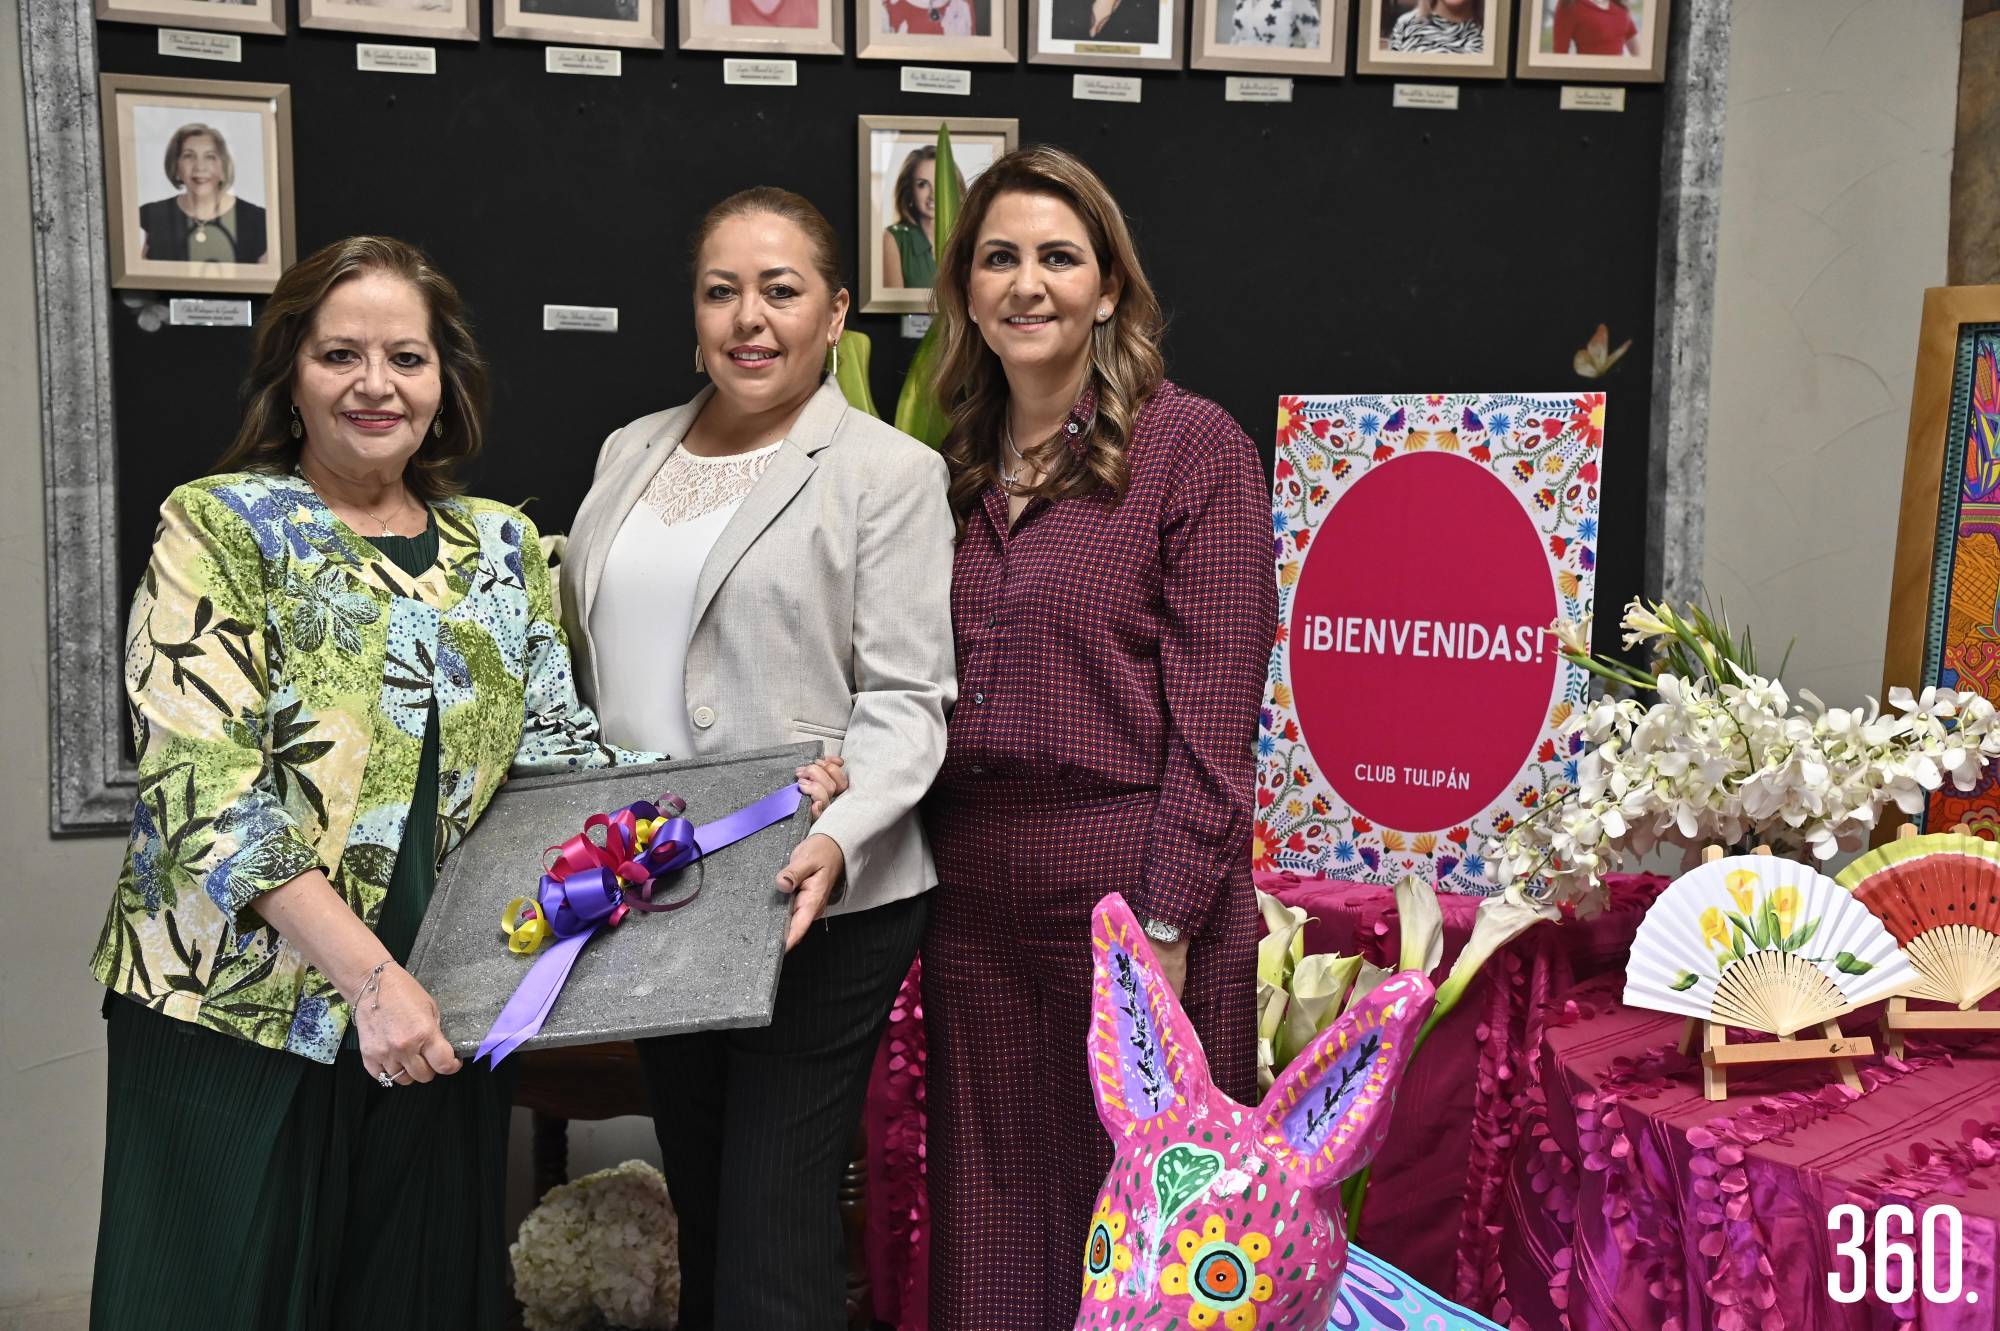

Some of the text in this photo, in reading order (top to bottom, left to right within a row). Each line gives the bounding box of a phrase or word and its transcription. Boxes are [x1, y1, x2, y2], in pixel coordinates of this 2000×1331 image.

[1303, 615, 1544, 664] ¡BIENVENIDAS!
[1354, 763, 1470, 790] CLUB TULIPÁN
